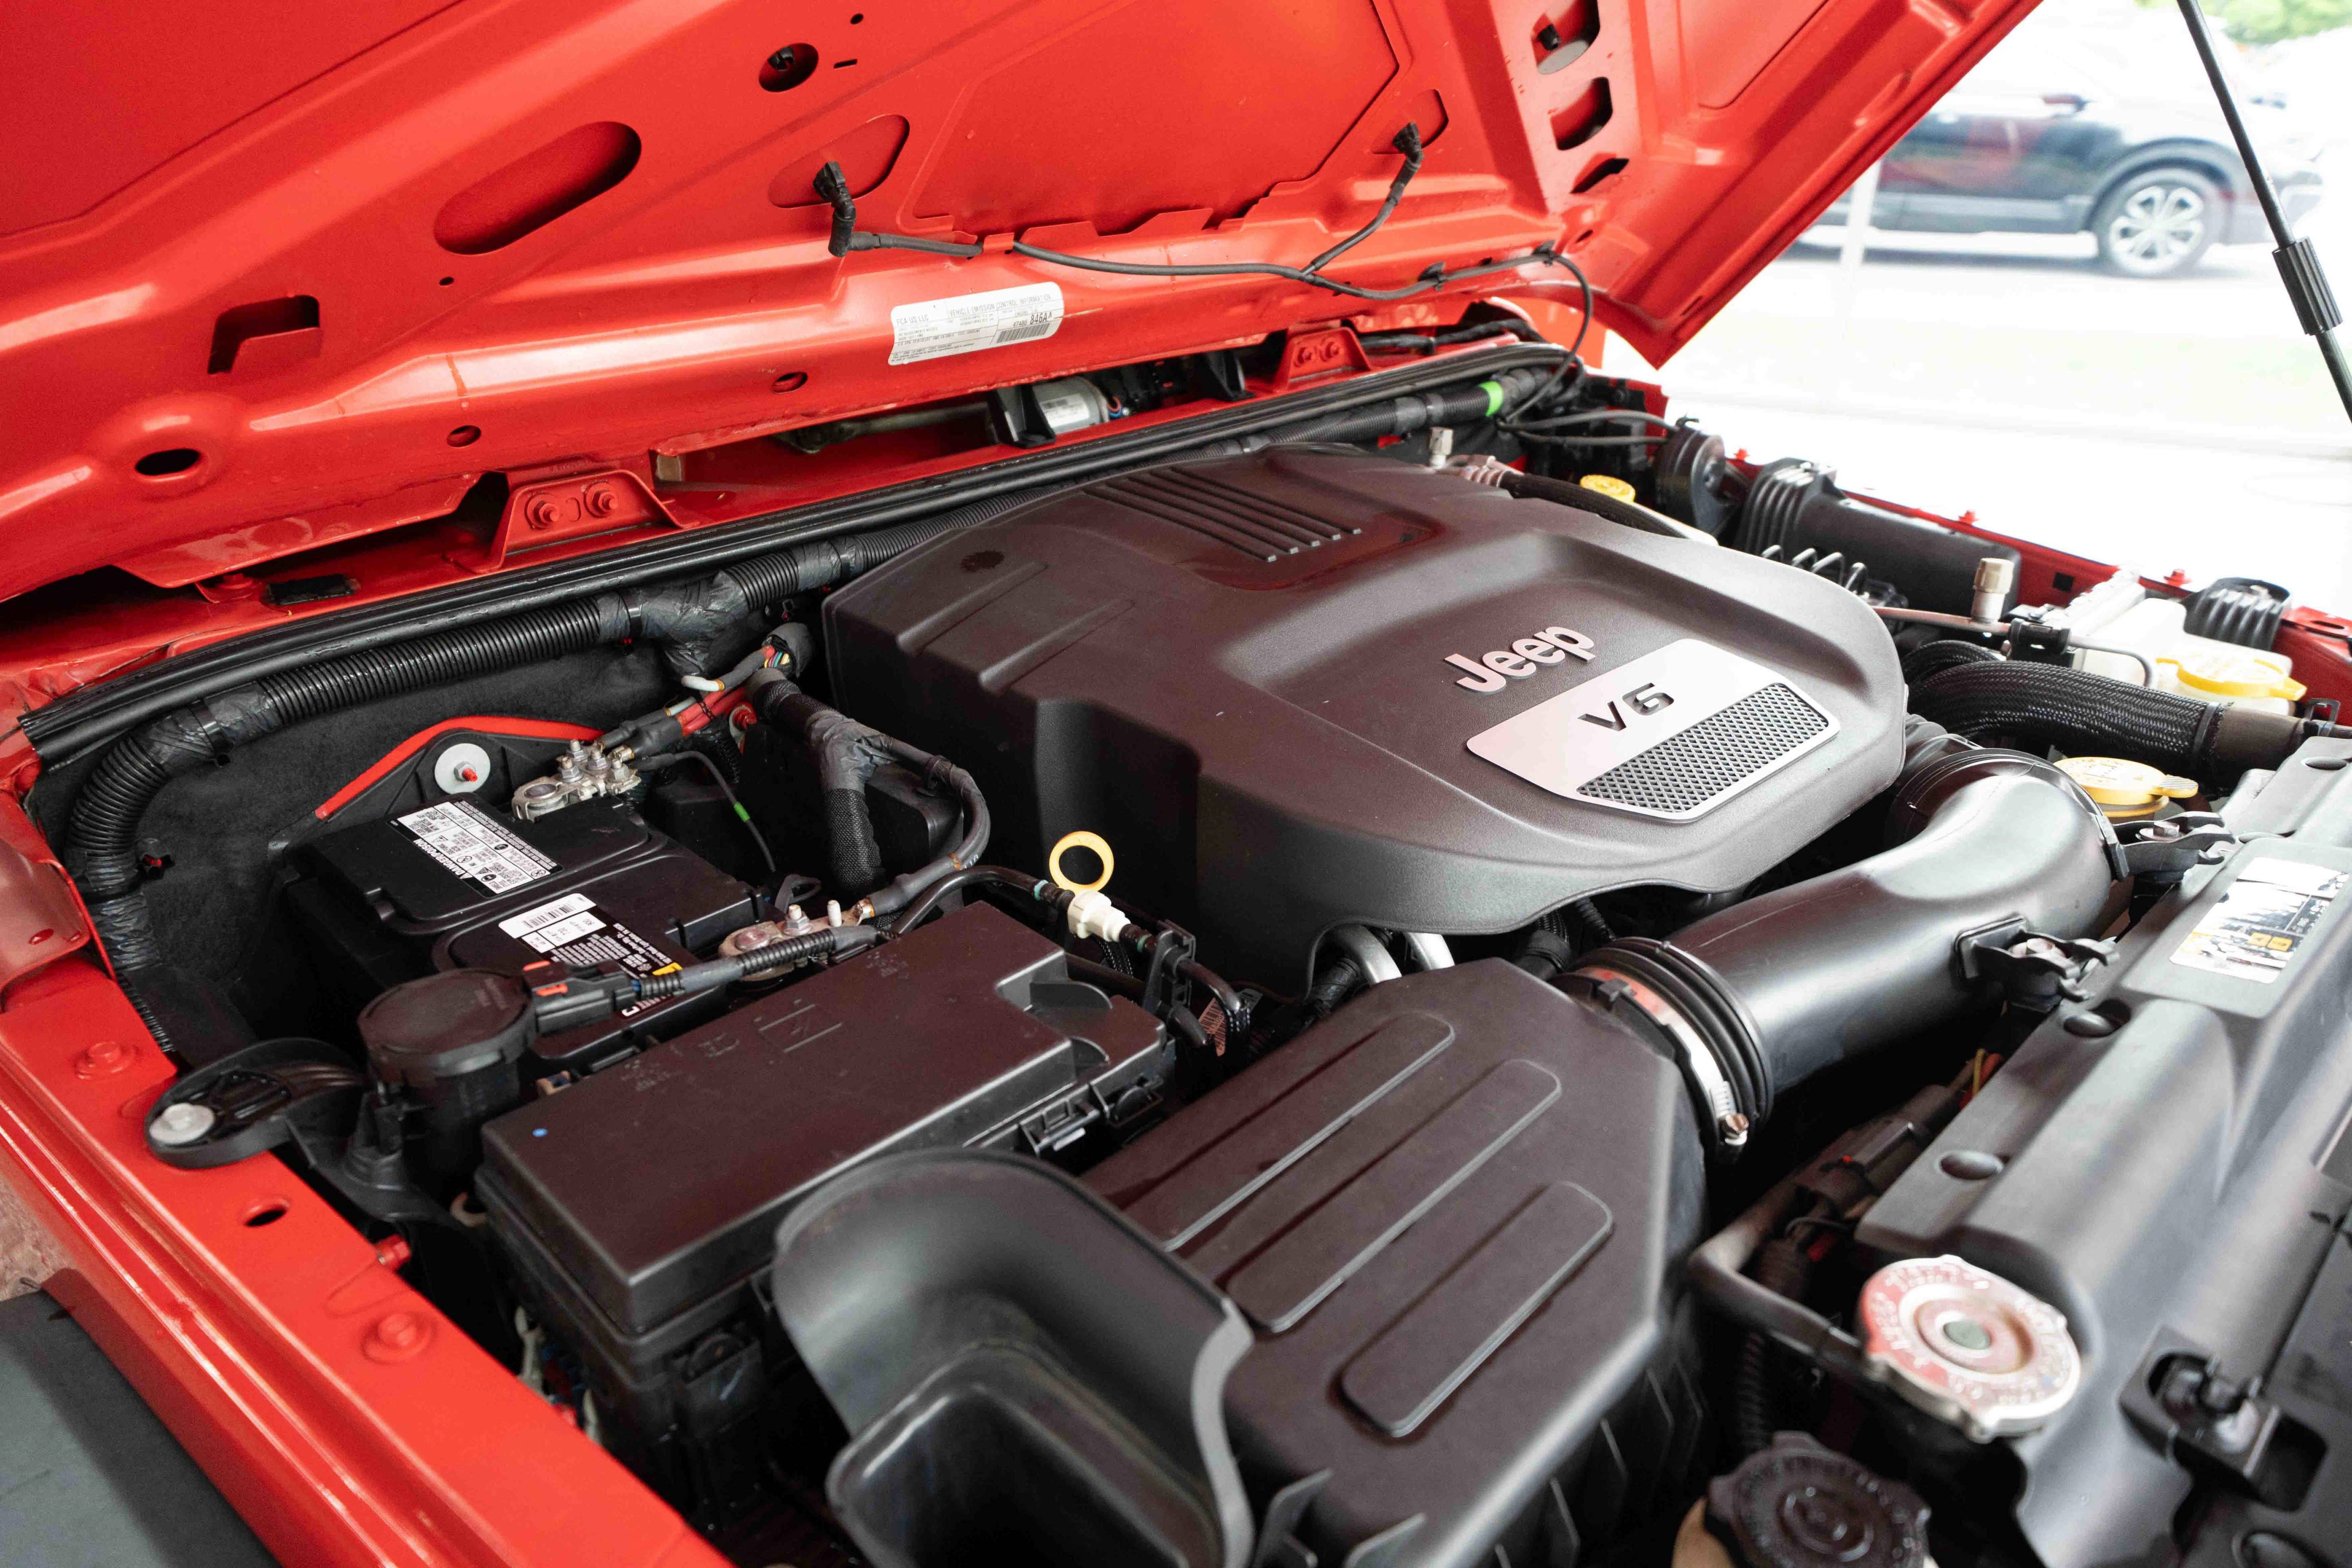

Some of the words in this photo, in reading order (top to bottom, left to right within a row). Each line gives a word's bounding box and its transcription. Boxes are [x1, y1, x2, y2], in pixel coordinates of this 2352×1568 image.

[896, 316, 908, 325] FCA
[909, 315, 917, 324] US
[918, 313, 929, 323] LLC
[949, 306, 971, 317] VEHICLE
[971, 303, 996, 314] EMISSION
[996, 299, 1018, 310] CONTROL
[1444, 626, 1595, 694] Jeep
[1577, 682, 1675, 732] V6
